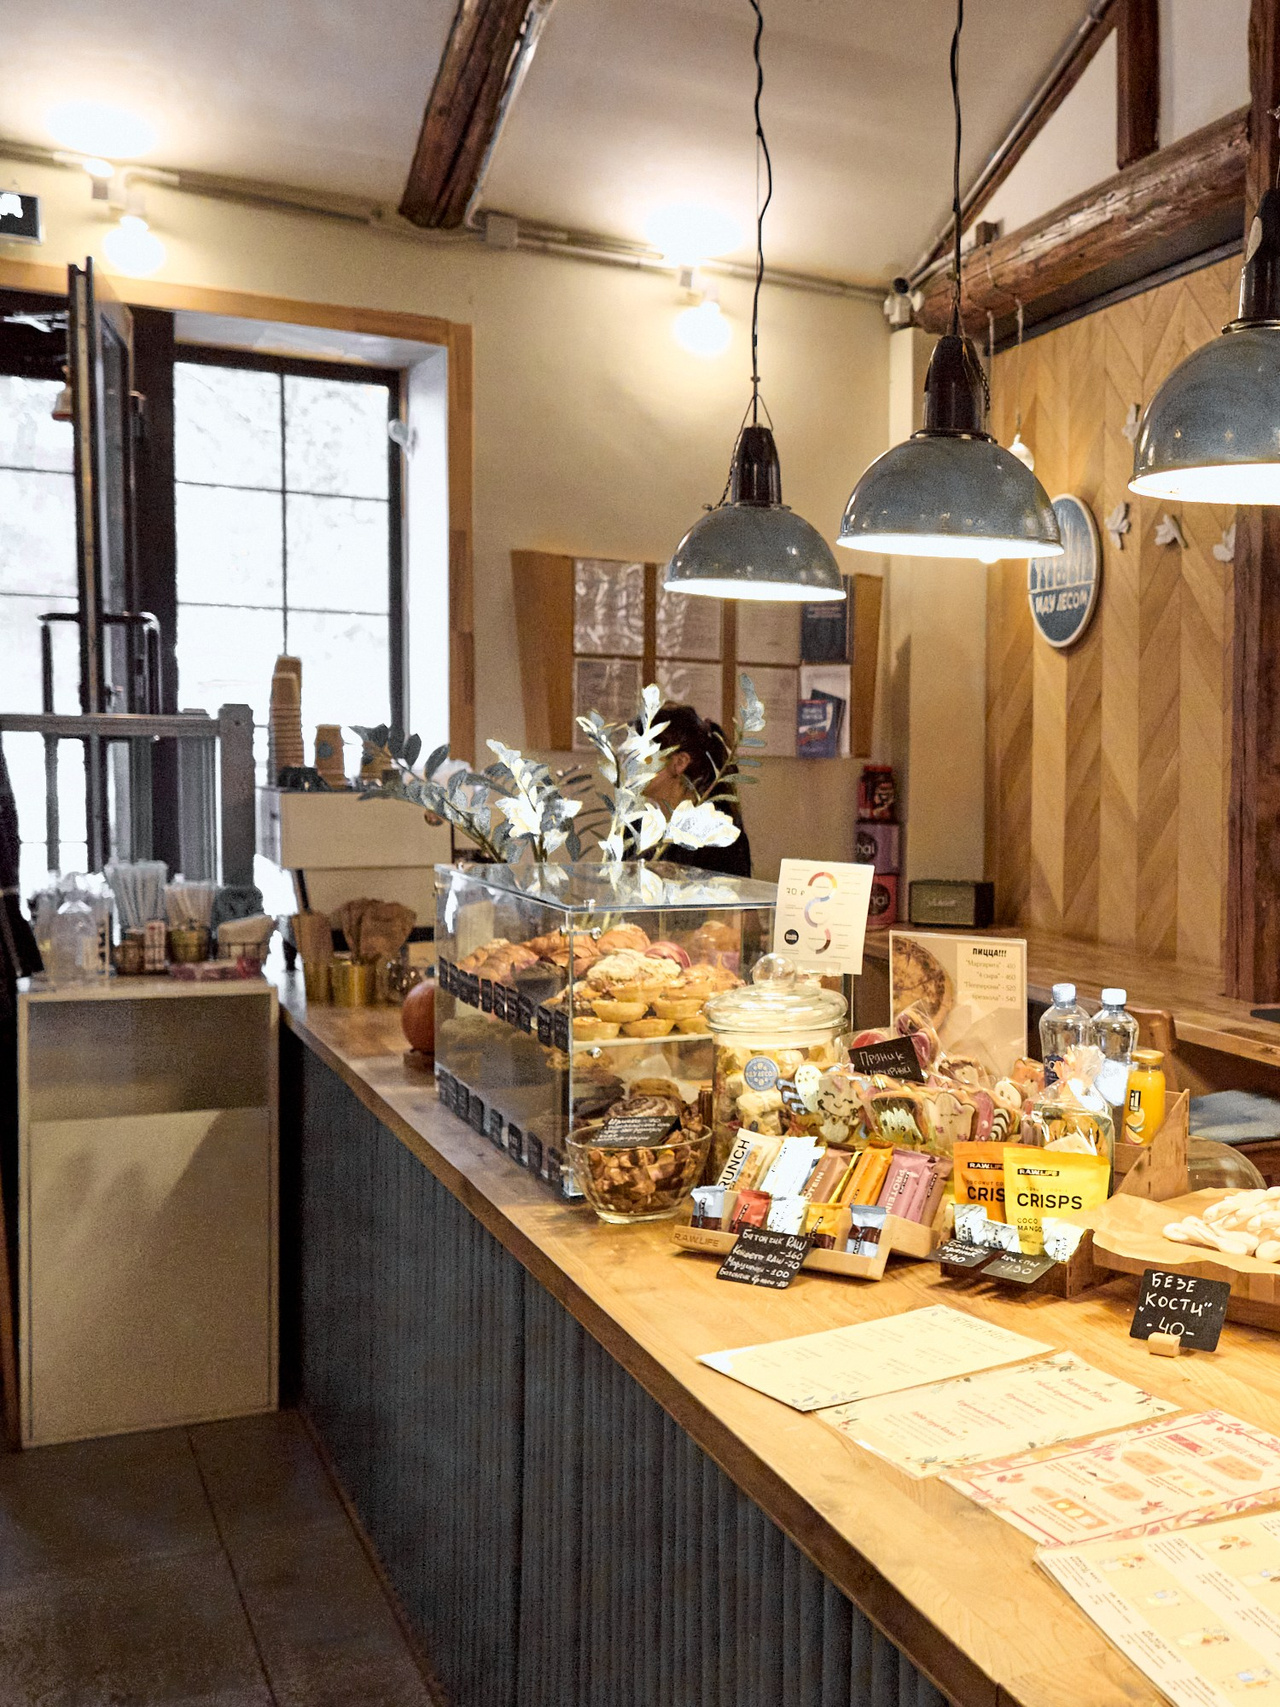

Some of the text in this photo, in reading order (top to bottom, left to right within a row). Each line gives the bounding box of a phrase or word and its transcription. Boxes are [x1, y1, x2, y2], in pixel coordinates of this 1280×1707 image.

[972, 947, 1007, 958] ПИЦЦА!!!
[718, 1139, 750, 1191] RUNCH
[967, 1186, 1005, 1203] CRIS
[1017, 1193, 1083, 1210] CRISPS
[1017, 1225, 1043, 1233] MANGO
[786, 1236, 807, 1251] RAW
[1152, 1272, 1198, 1293] БЕЗЕ
